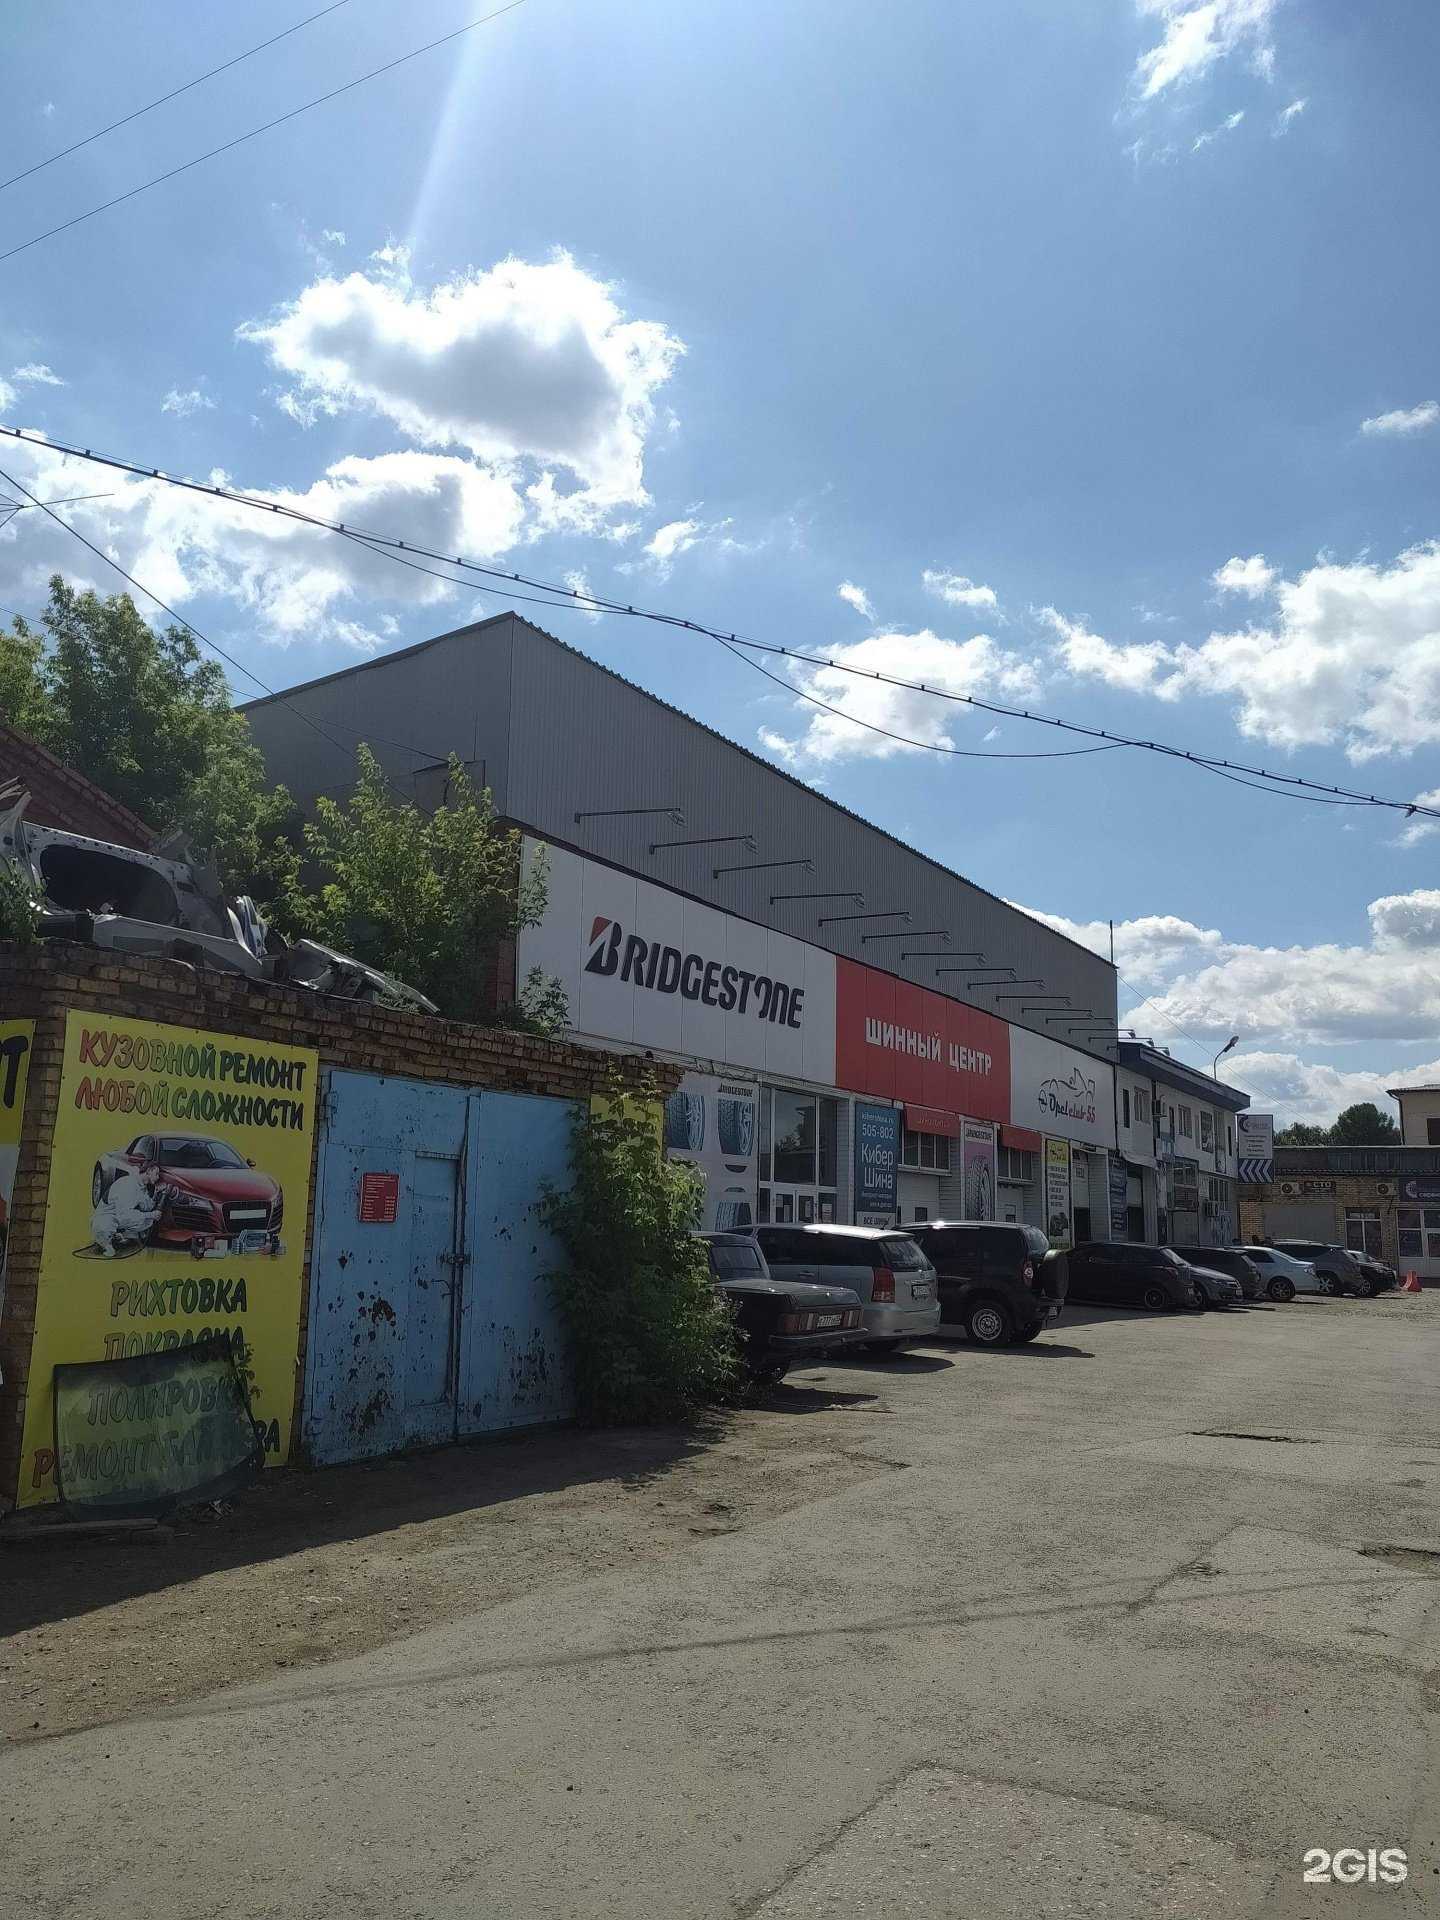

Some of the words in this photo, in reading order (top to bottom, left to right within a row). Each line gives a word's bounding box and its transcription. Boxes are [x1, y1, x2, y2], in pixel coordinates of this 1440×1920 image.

[584, 916, 805, 1029] BRIDGESTONE
[79, 1028, 216, 1080] КУЗОВНОЙ
[219, 1051, 307, 1092] РЕМОНТ
[865, 1017, 942, 1062] ШИННЫЙ
[950, 1042, 992, 1076] ЦЕНТР
[74, 1076, 168, 1118] ЛЮБОЙ
[171, 1089, 304, 1131] СЛОЖНОСТИ
[861, 1143, 894, 1173] Кибер
[864, 1170, 893, 1189] Шина
[110, 1278, 247, 1317] РИХТОВКА
